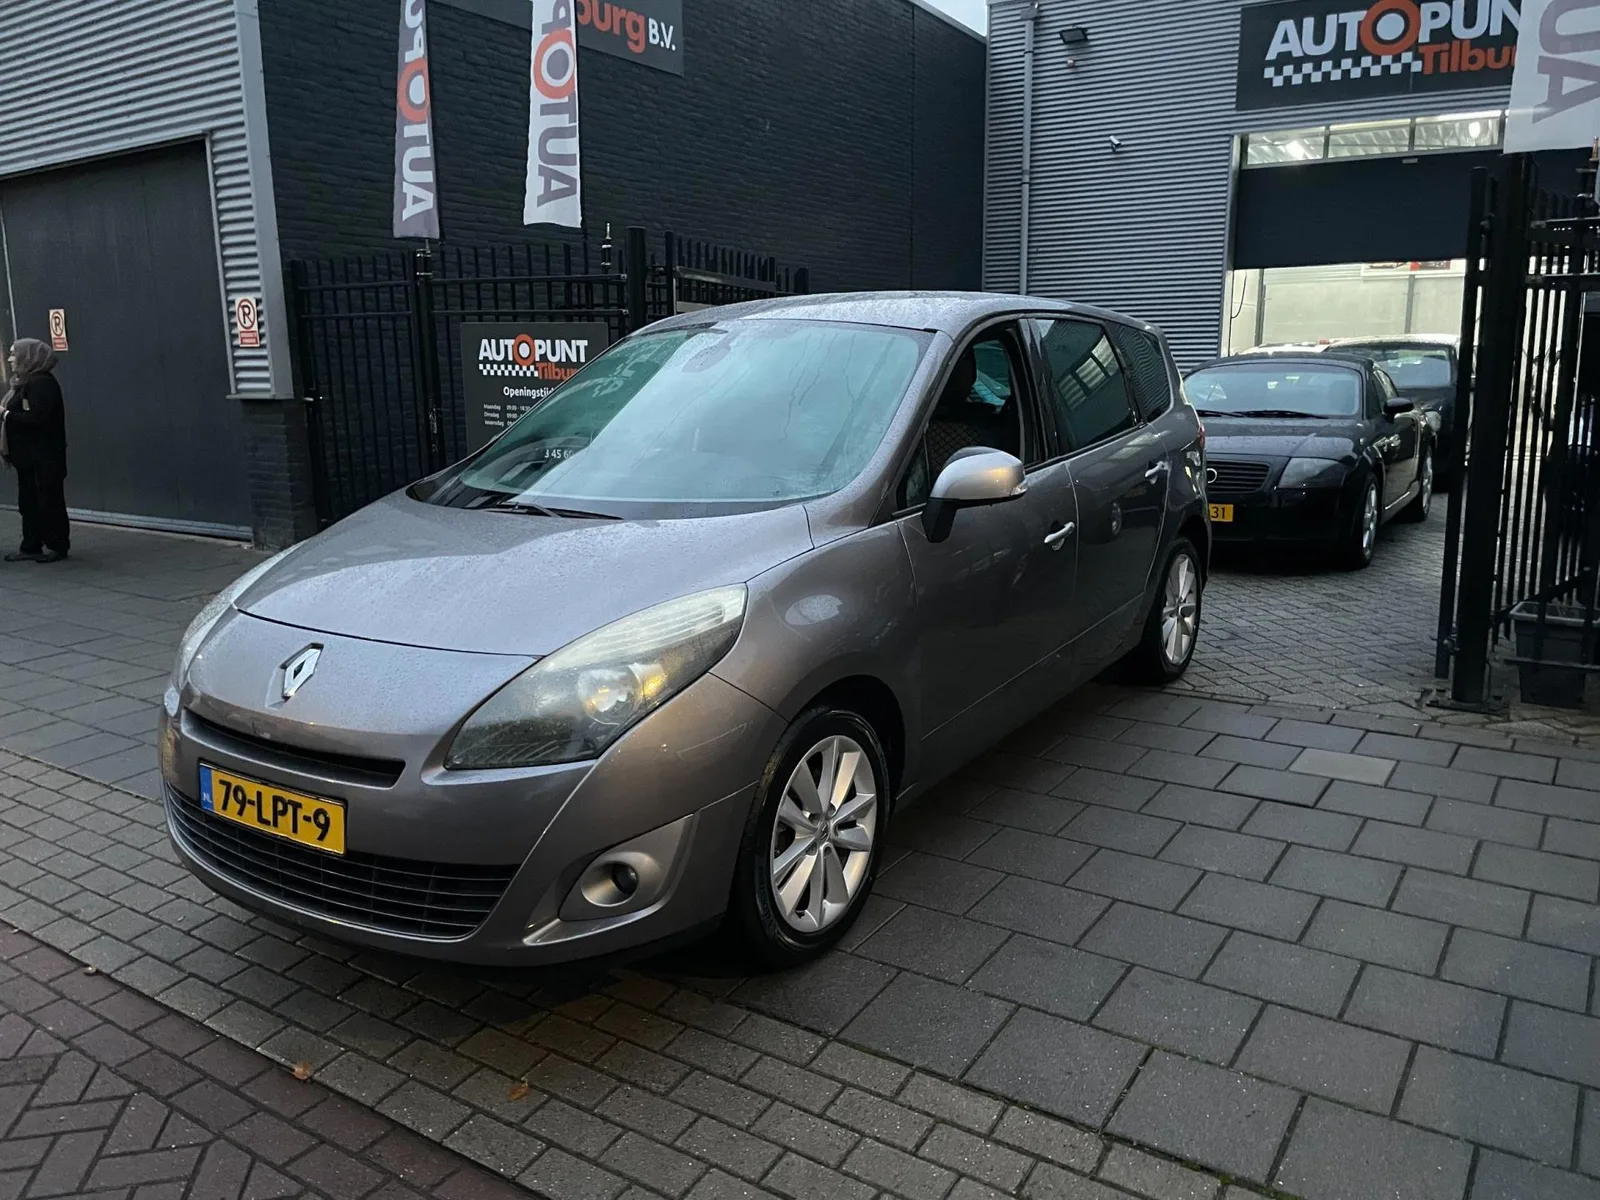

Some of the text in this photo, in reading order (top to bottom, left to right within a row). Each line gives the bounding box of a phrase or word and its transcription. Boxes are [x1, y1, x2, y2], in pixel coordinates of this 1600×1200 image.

[648, 18, 677, 51] B.V.
[479, 334, 588, 366] AUTOPUNT
[551, 448, 562, 459] 45
[219, 779, 331, 842] 79-LPT-9
